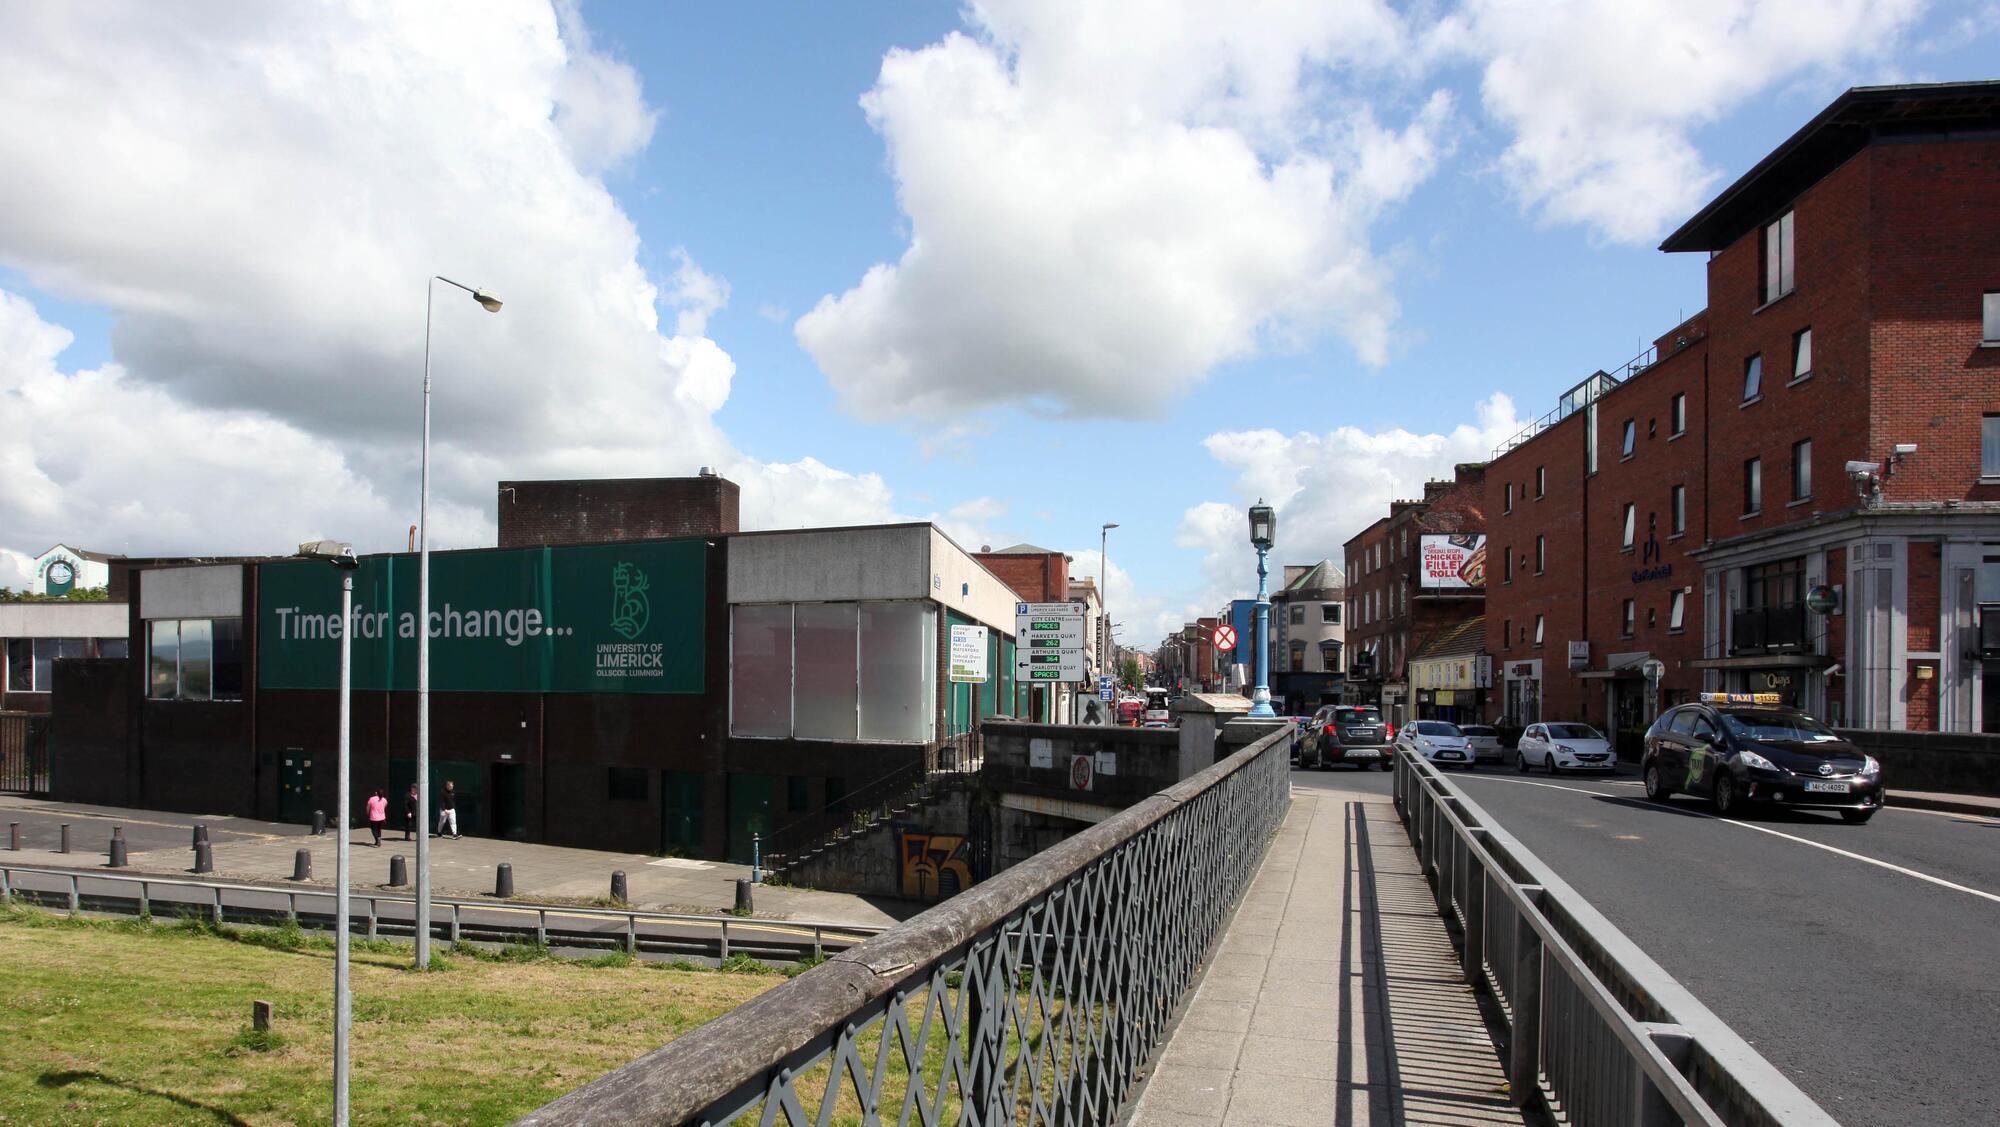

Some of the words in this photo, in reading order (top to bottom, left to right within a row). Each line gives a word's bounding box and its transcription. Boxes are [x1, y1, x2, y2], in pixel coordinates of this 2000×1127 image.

[1426, 560, 1462, 570] FILLET
[1430, 570, 1456, 578] ROLL
[276, 606, 342, 639] Time
[351, 604, 389, 638] for
[399, 611, 415, 638] a
[596, 643, 648, 653] UNIVERSITY
[650, 643, 663, 653] OF
[596, 653, 663, 667] LIMERICK
[596, 669, 627, 677] OLLSCOIL
[629, 669, 664, 677] LUIMNIGH
[1767, 673, 1791, 688] Quays
[1730, 694, 1751, 702] TAXI
